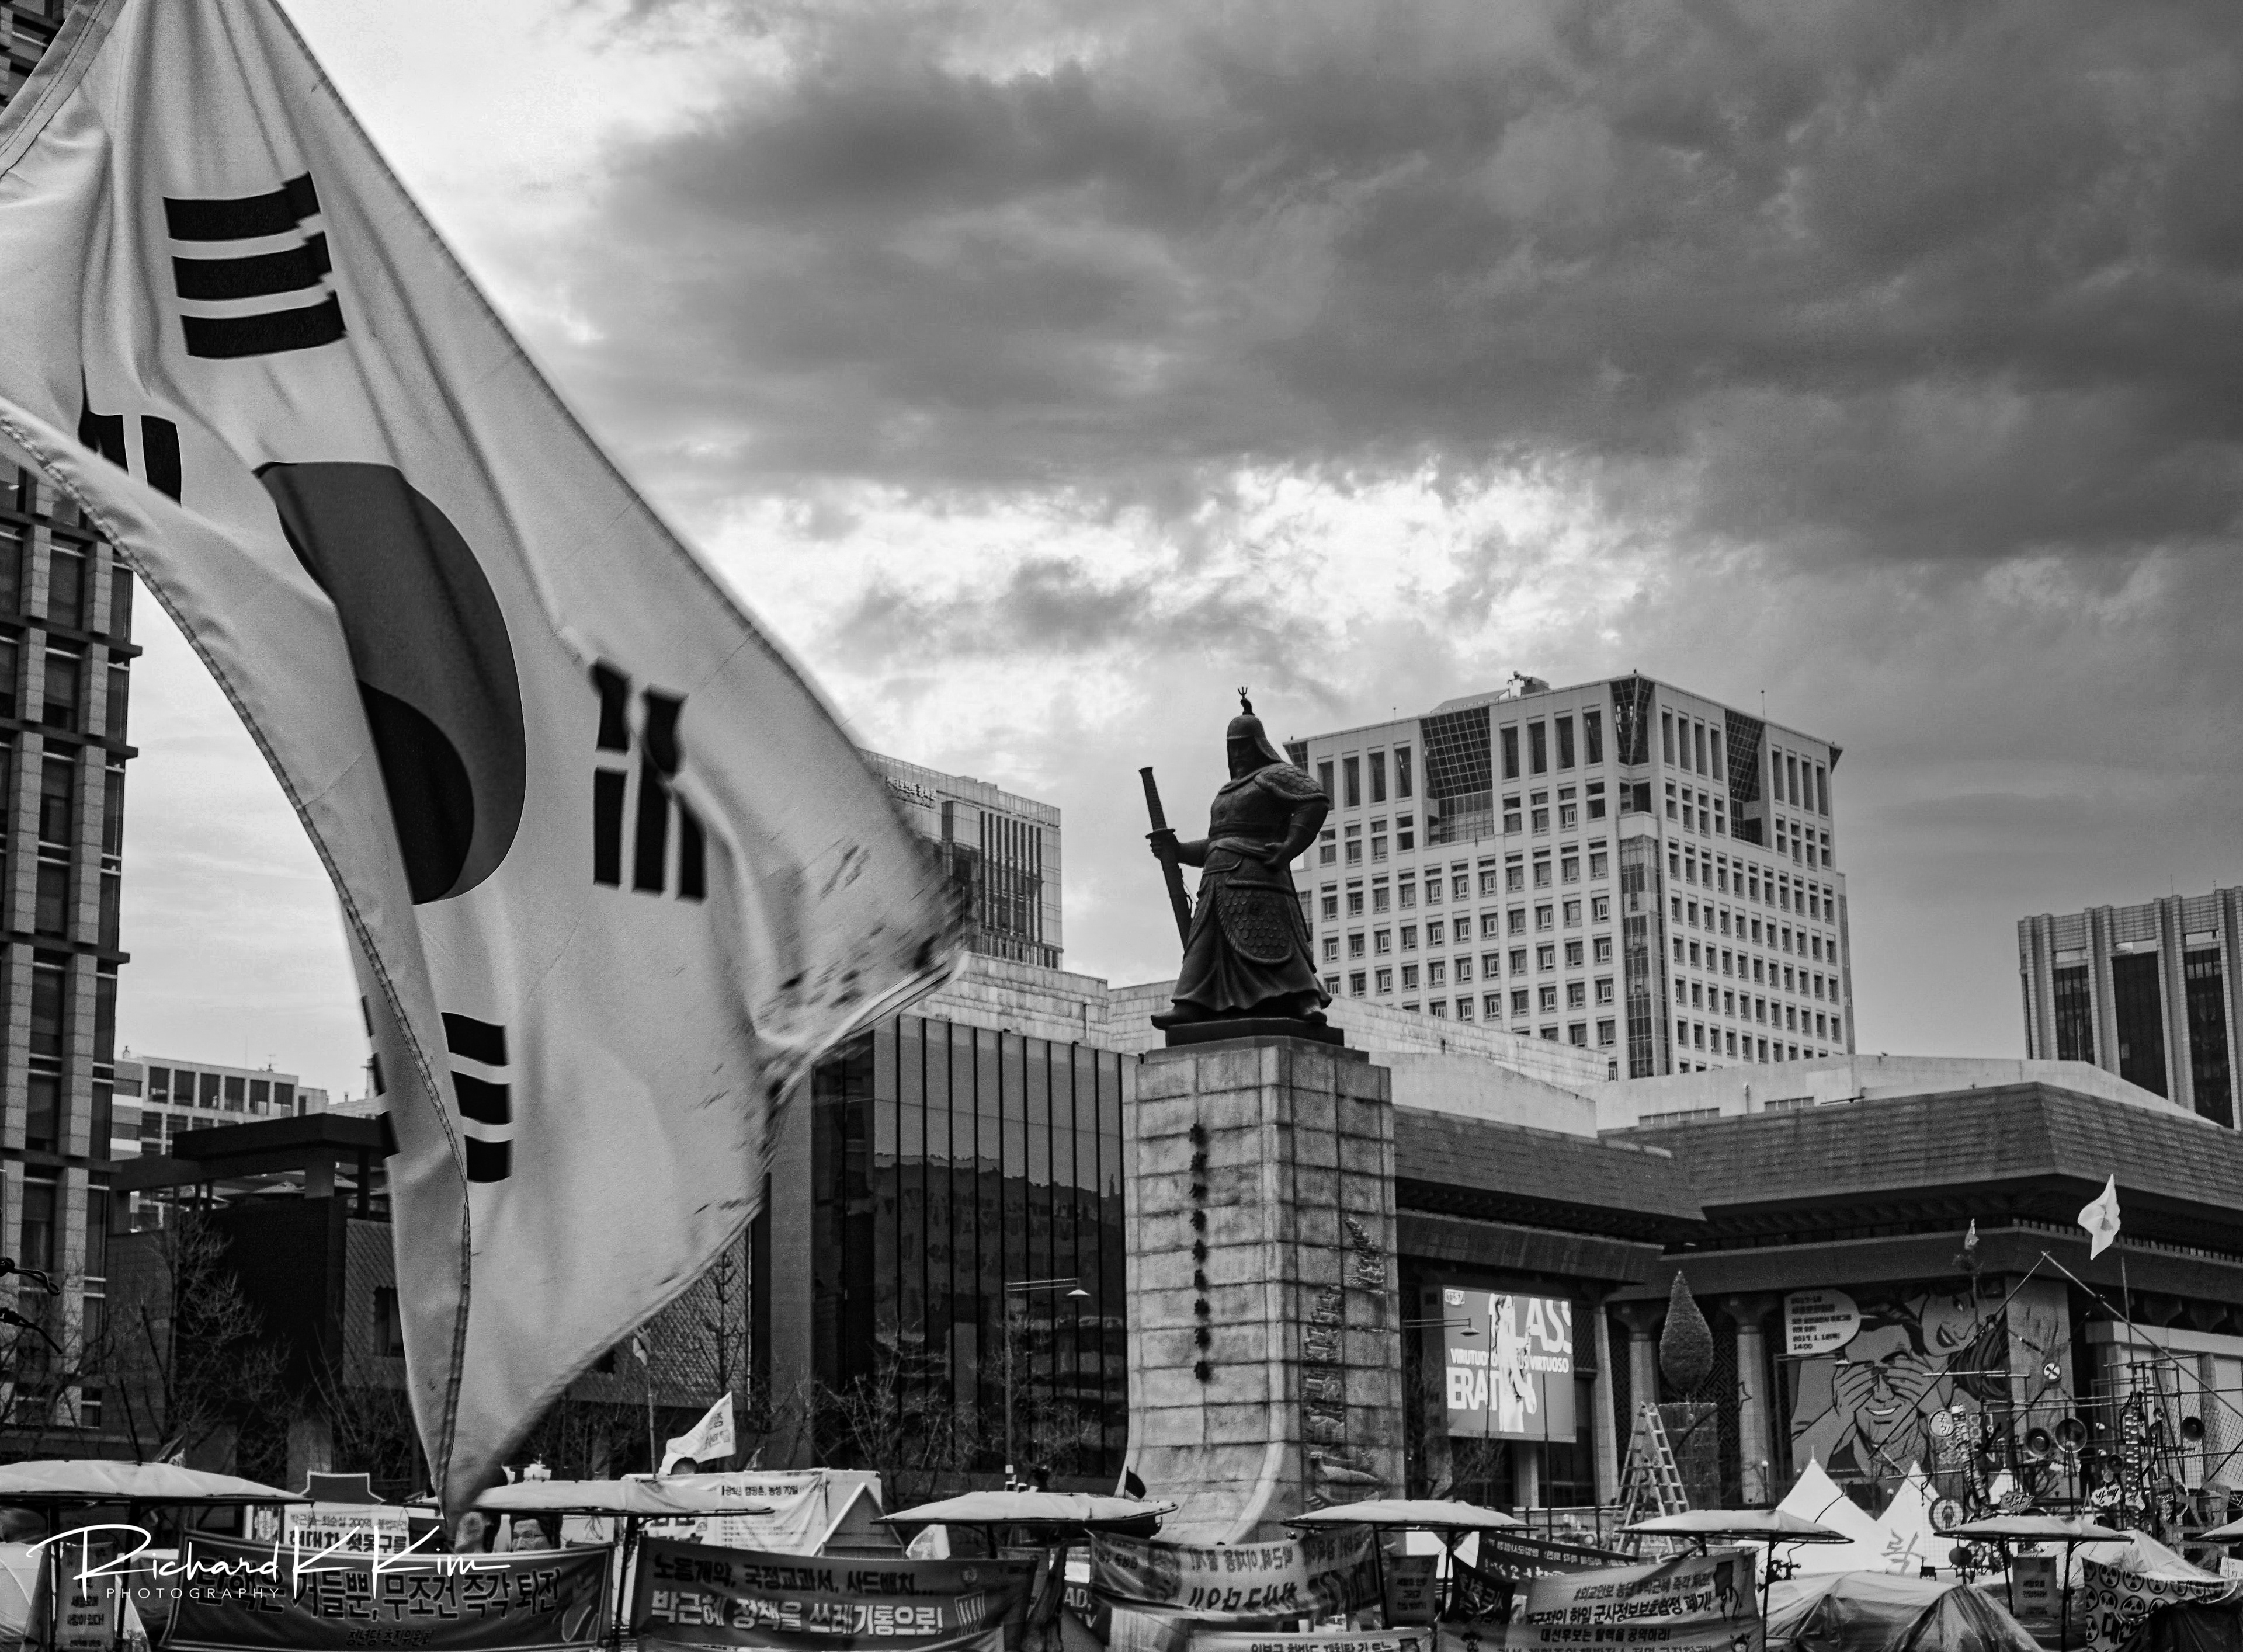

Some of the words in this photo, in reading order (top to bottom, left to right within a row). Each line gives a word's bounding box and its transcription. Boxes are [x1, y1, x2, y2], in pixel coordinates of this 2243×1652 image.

[383, 1573, 460, 1622] 무조건
[461, 1570, 512, 1619] 즉각
[515, 1567, 561, 1616] 퇴진
[651, 1590, 728, 1627] 박근혜
[732, 1597, 803, 1632] 정책을
[809, 1603, 943, 1636] 쓰레기통으로!
